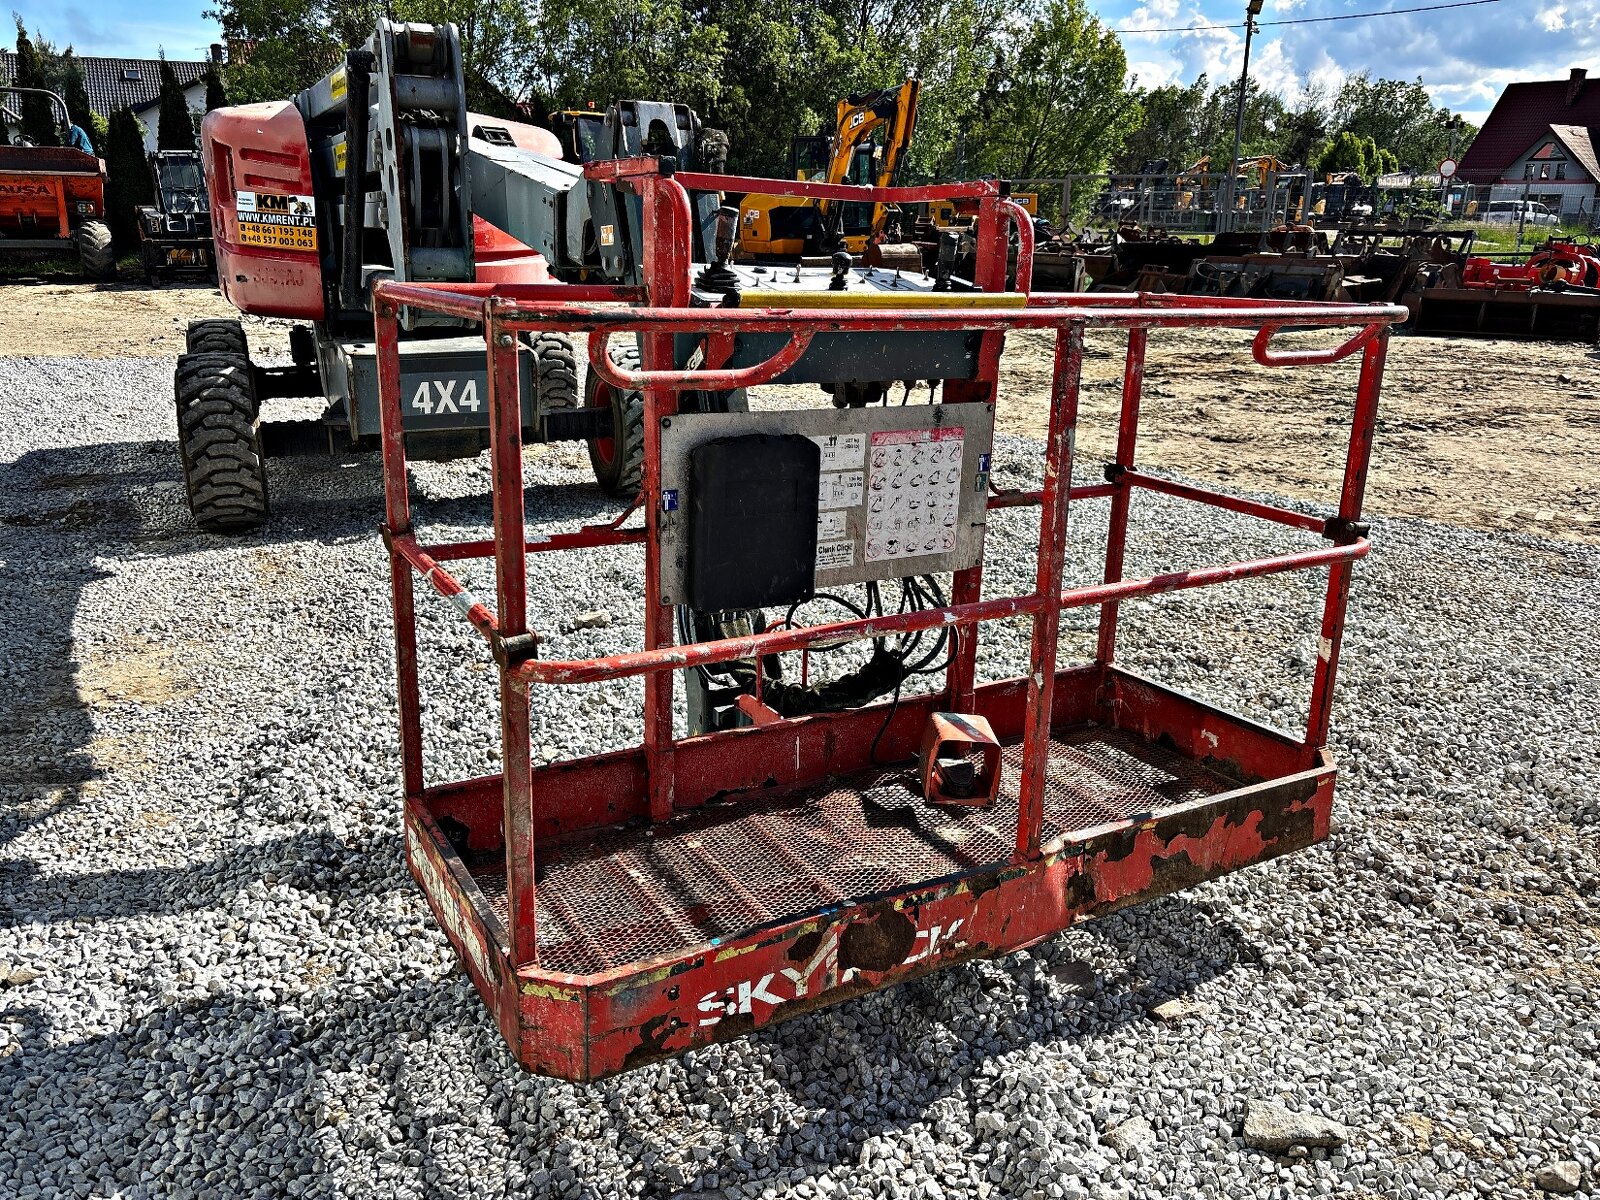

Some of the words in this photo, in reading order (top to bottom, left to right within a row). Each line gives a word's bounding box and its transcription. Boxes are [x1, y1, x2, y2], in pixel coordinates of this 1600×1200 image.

[849, 112, 865, 129] JCB
[257, 194, 288, 209] KM
[238, 212, 316, 227] WWW.KMRENT.PL
[247, 224, 260, 233] +48
[262, 226, 276, 235] 661
[280, 227, 294, 236] 195
[297, 229, 313, 238] 148
[248, 234, 261, 243] +48
[263, 236, 277, 244] 537
[279, 238, 295, 246] 003
[297, 239, 313, 247] 063
[412, 379, 481, 414] 4X4
